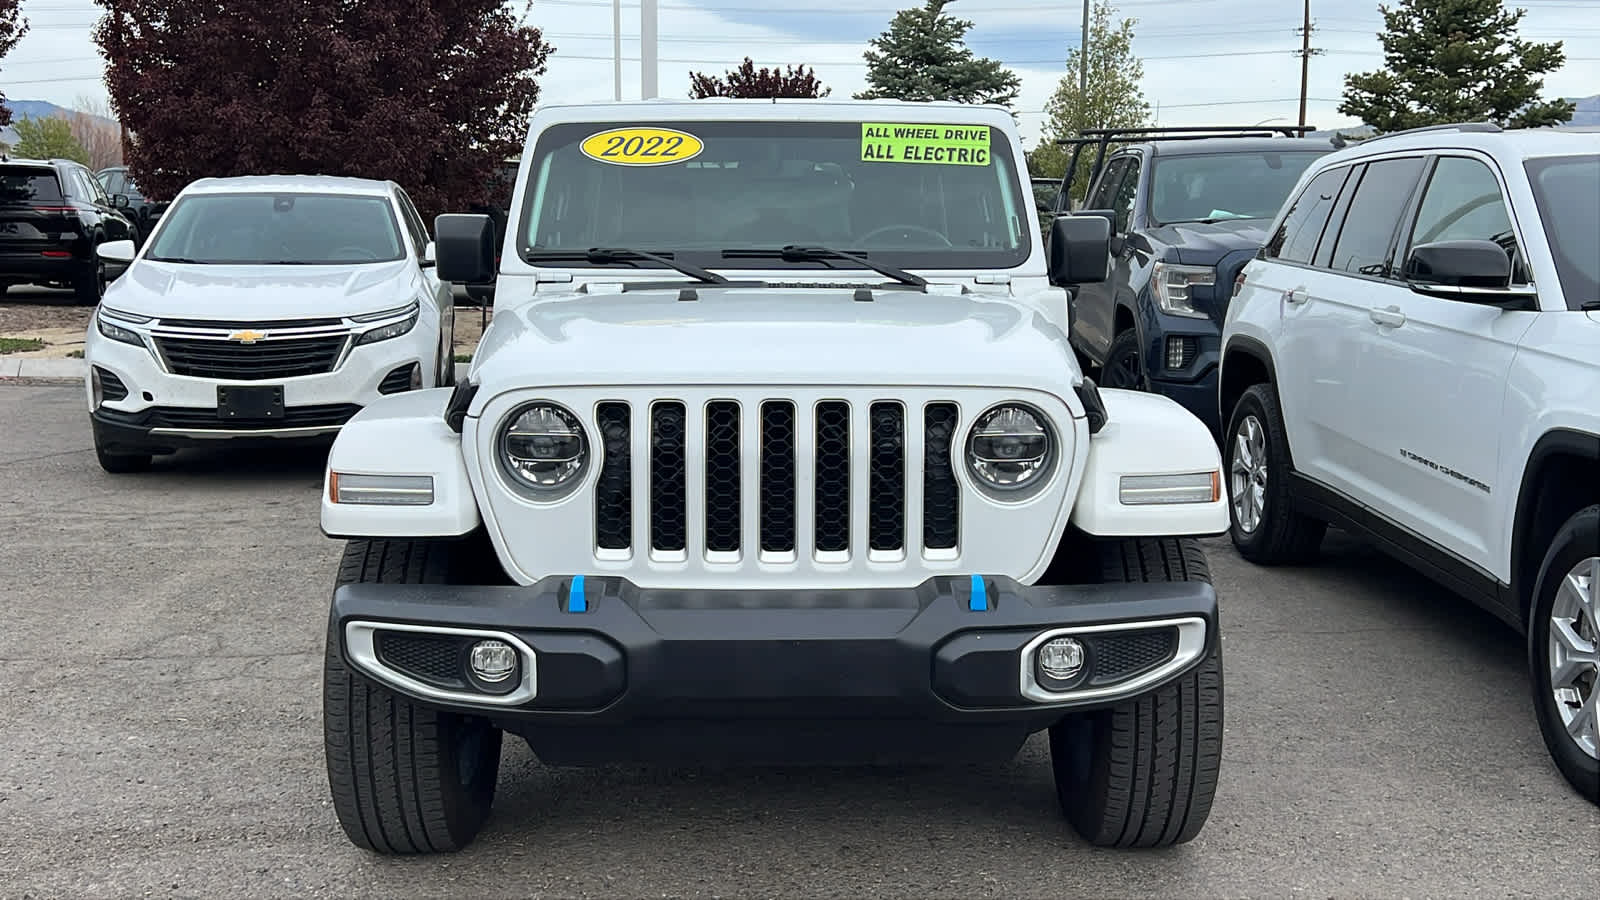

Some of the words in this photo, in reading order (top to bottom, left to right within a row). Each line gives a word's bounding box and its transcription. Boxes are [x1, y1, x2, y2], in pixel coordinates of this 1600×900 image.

[865, 127, 890, 138] ALL
[894, 127, 940, 139] WHEEL
[944, 129, 988, 141] DRIVE
[600, 136, 683, 156] 2022
[863, 143, 894, 159] ALL
[903, 145, 987, 163] ELECTRIC
